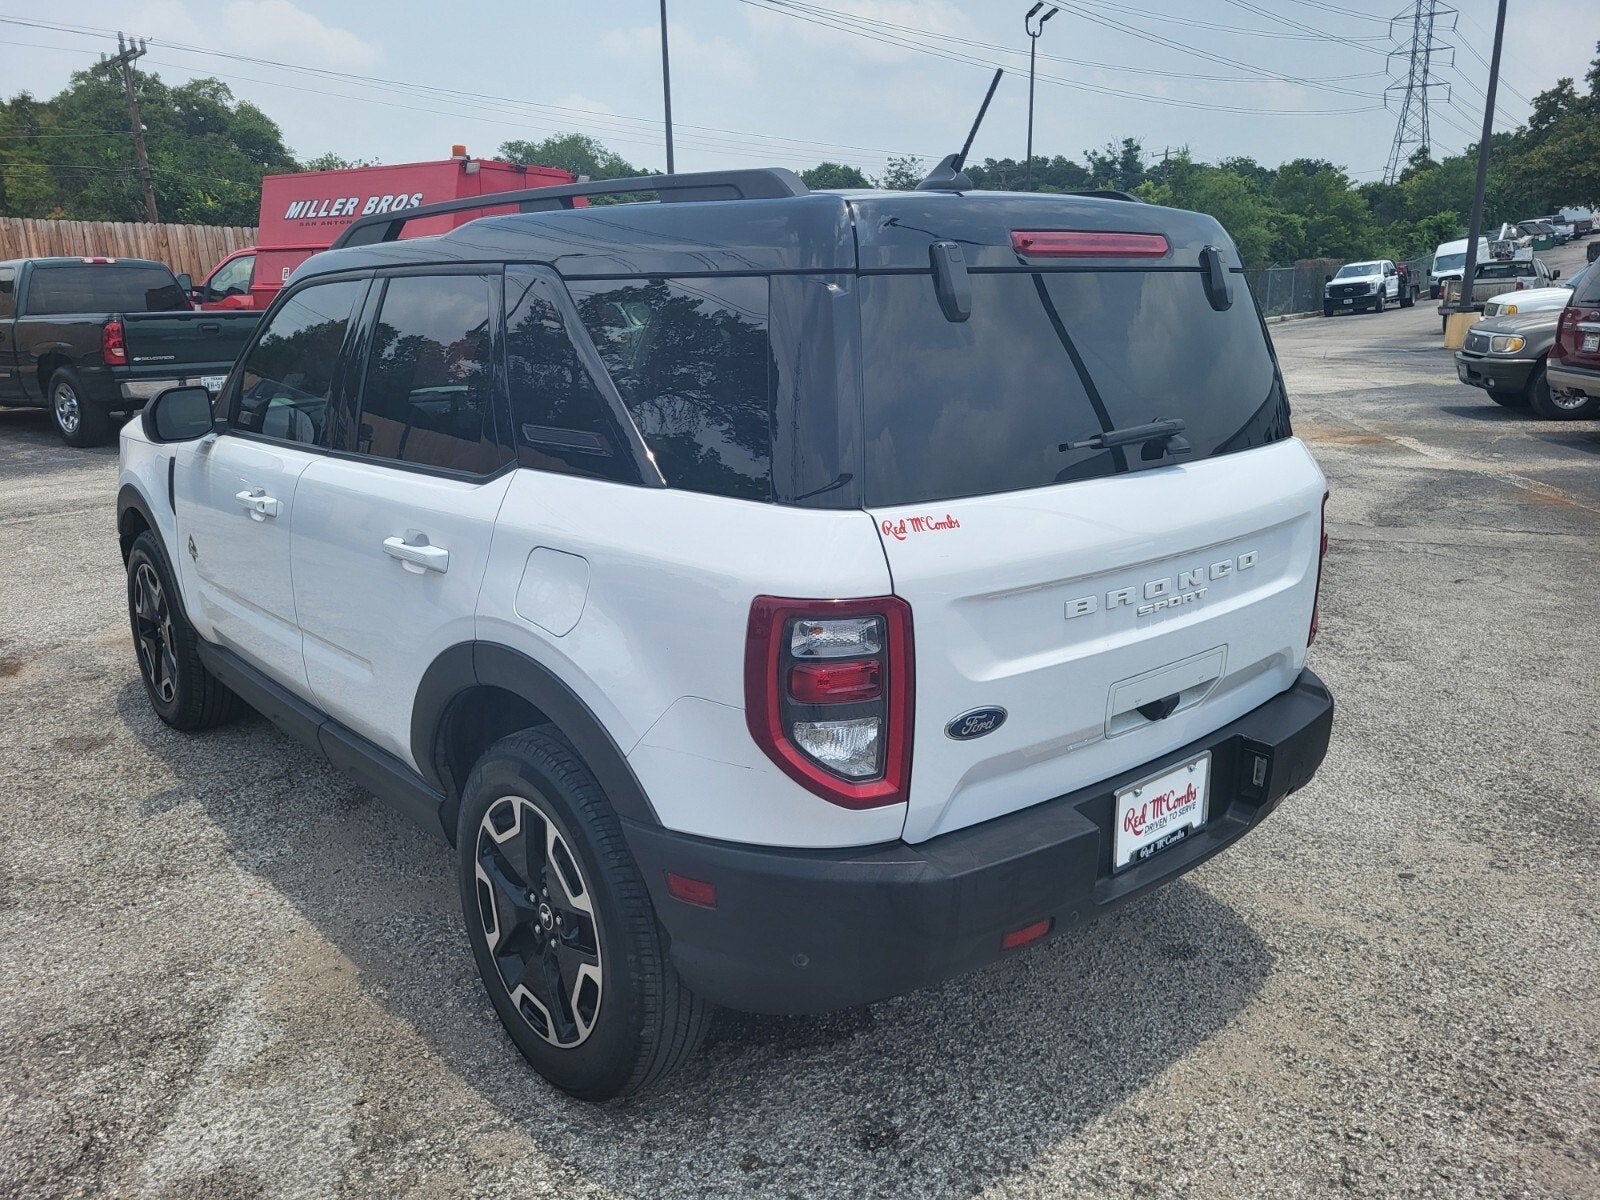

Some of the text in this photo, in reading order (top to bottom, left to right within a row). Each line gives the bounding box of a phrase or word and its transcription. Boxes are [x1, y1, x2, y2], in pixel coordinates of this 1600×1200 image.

[284, 192, 423, 219] MILLER BROS
[881, 514, 960, 541] Red McCombs
[1064, 550, 1259, 620] BRONCO
[1137, 587, 1209, 617] SPORT
[961, 708, 996, 736] Ford
[1124, 782, 1197, 836] Red McCombs
[1144, 801, 1197, 835] DRIVEN TO SERVE
[1139, 843, 1154, 858] Red
